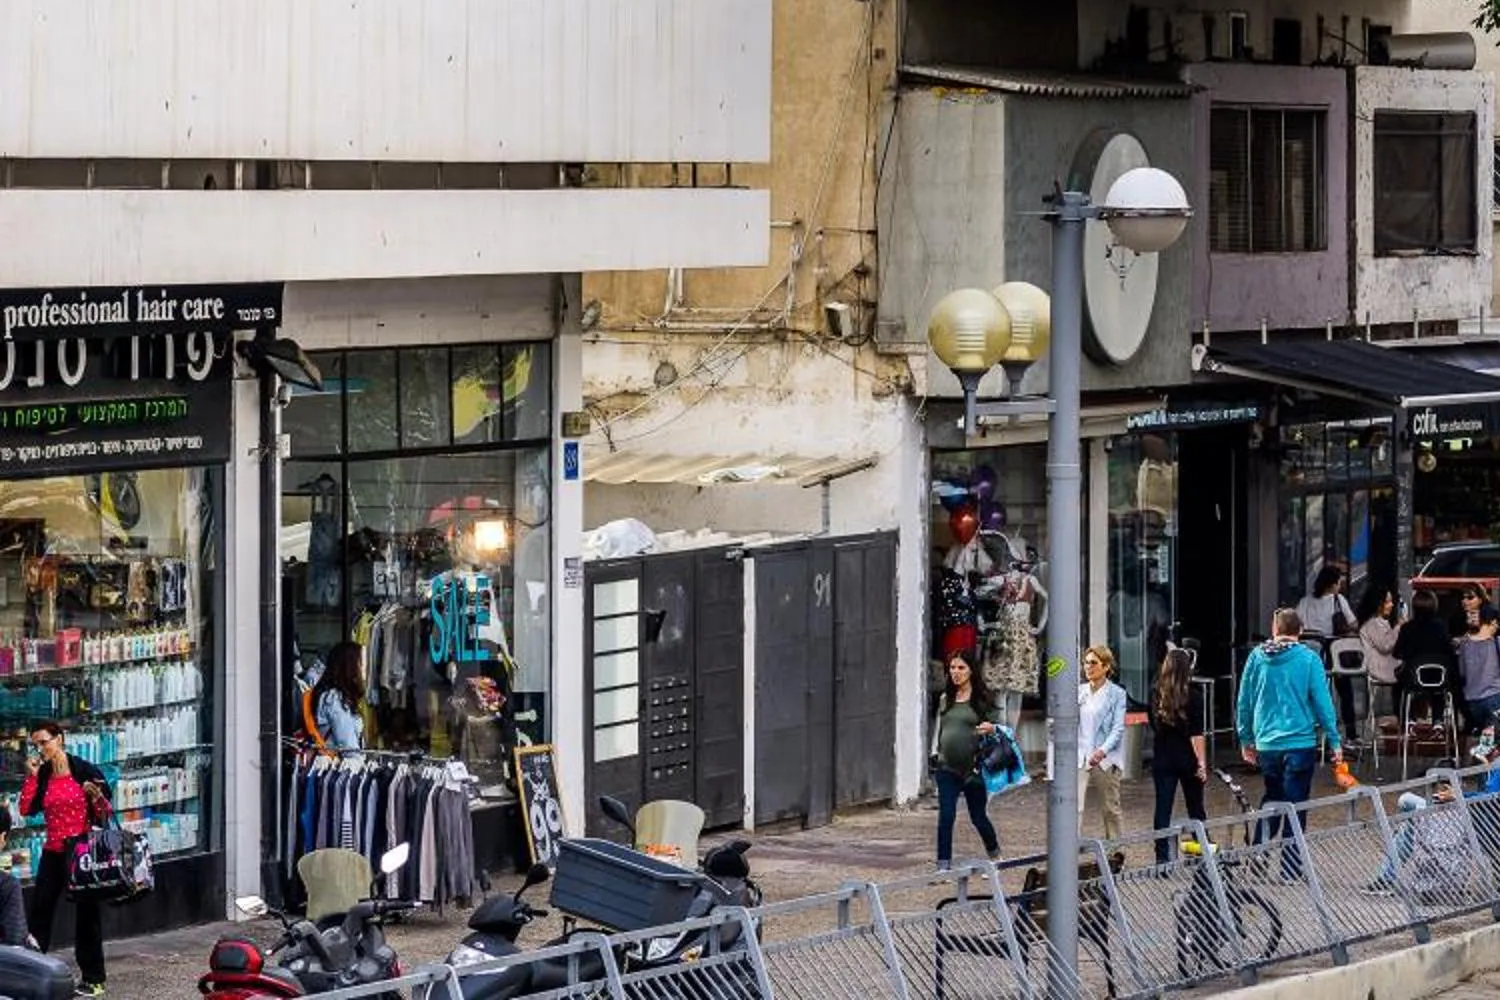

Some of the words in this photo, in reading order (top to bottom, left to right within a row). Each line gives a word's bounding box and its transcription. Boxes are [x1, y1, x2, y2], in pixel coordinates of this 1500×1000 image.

[4, 290, 130, 339] professional
[136, 289, 177, 322] hair
[182, 297, 225, 321] care
[15, 404, 67, 427] לטיפוח
[145, 399, 188, 418] המרכז
[814, 571, 831, 608] 91
[430, 574, 490, 664] SALE
